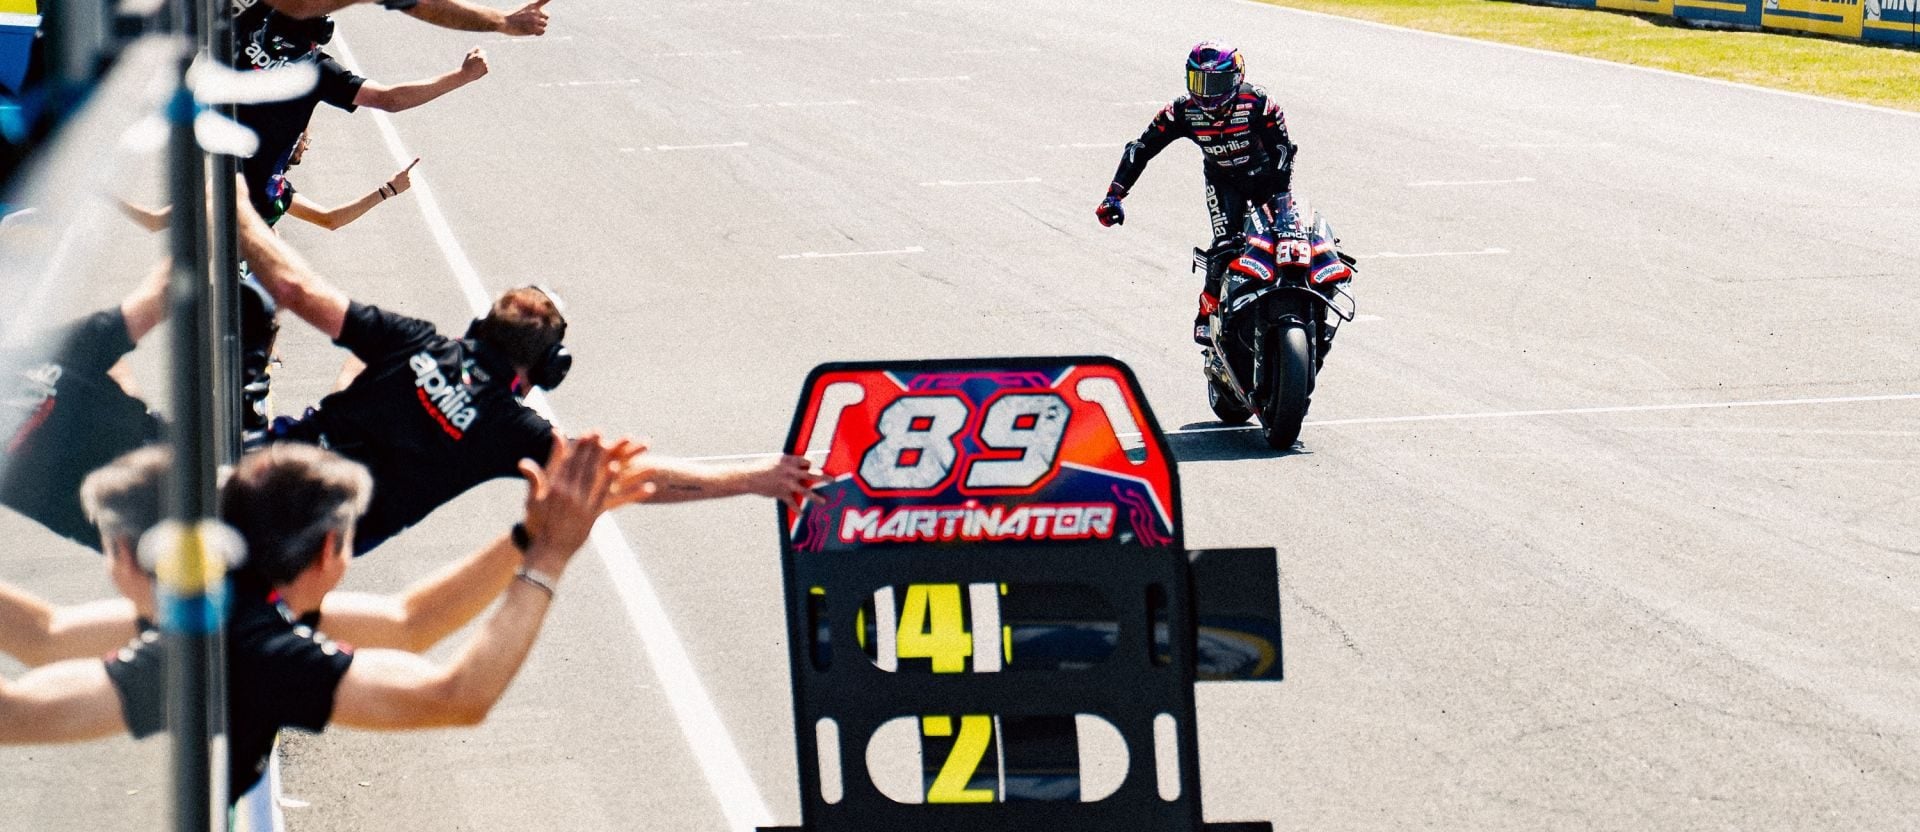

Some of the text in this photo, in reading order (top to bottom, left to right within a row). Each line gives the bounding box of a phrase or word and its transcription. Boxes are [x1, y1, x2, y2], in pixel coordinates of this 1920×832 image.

[1203, 140, 1250, 156] aprilia
[1206, 184, 1229, 238] aprilia
[409, 352, 477, 431] aprilia
[858, 391, 1072, 491] 89
[840, 502, 1114, 539] MARTINATOR
[922, 715, 995, 804] 2
